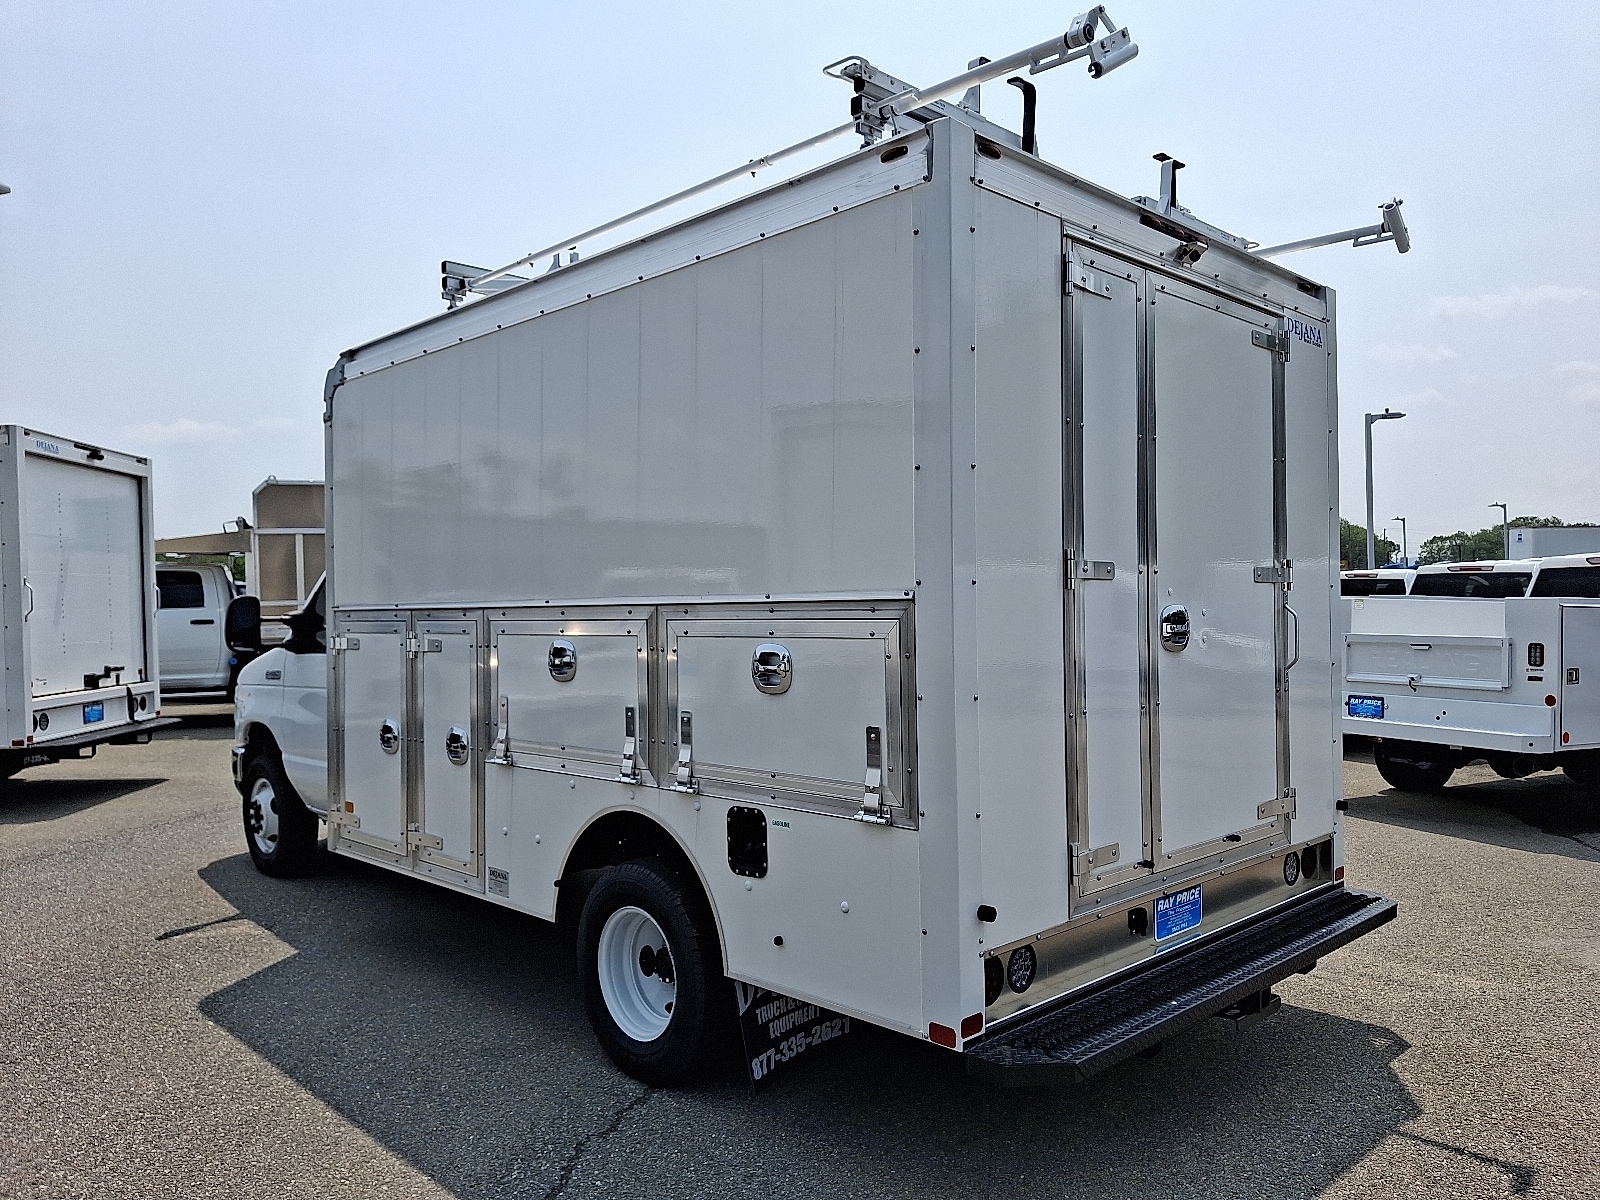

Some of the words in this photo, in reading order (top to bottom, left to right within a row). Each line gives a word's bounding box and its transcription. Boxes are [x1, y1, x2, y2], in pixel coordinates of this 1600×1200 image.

[1287, 317, 1322, 344] DEJANA
[1158, 896, 1175, 911] RAY
[1176, 887, 1200, 905] PRICE
[756, 999, 787, 1025] TRUCK
[751, 1016, 850, 1080] 877-335-2621
